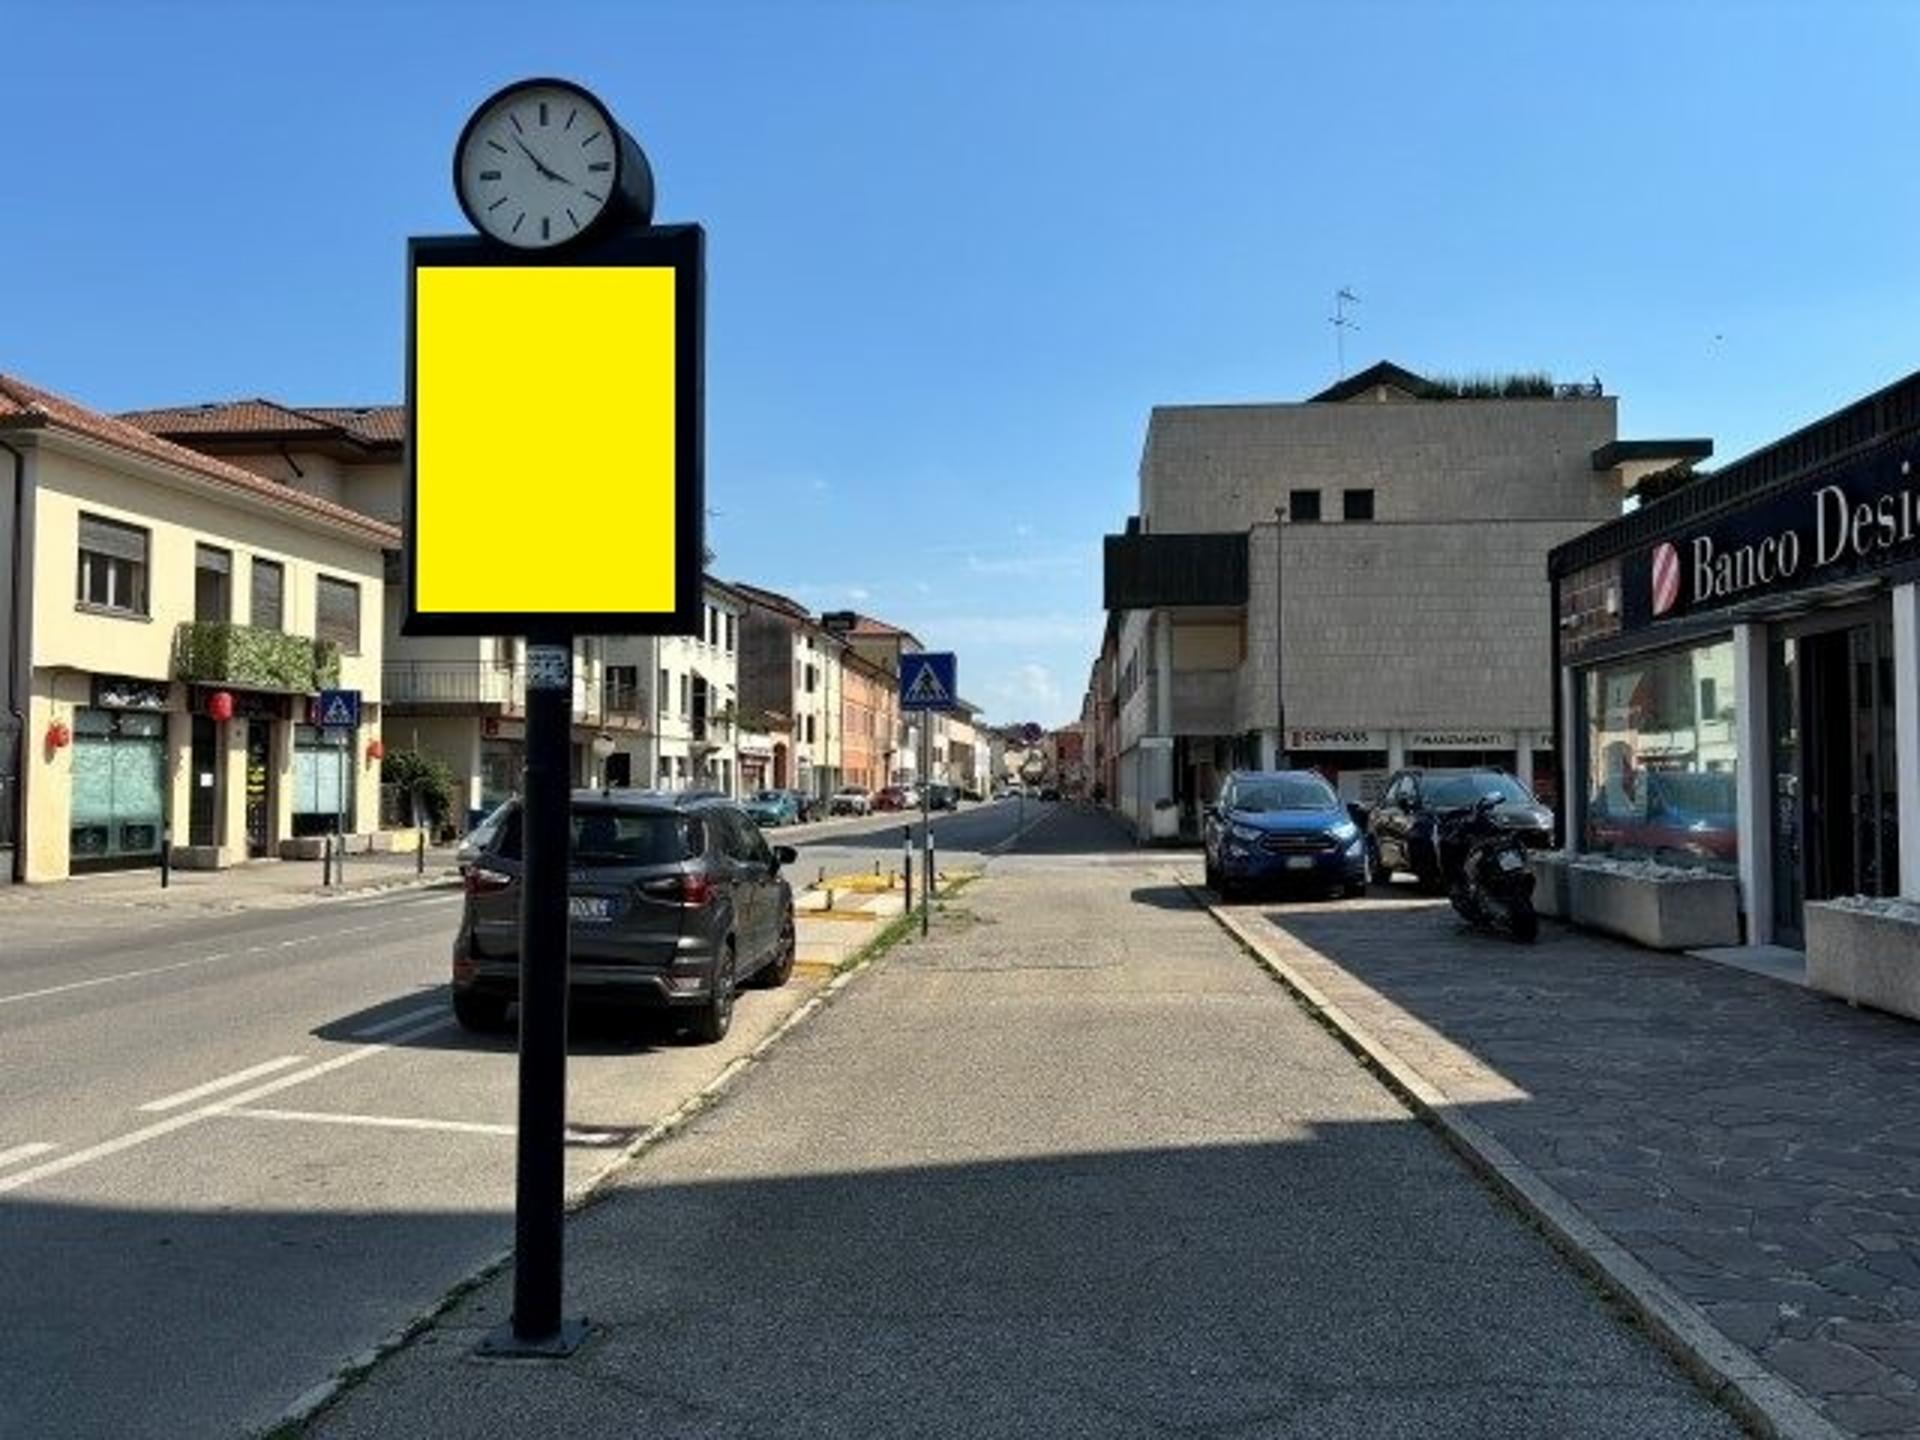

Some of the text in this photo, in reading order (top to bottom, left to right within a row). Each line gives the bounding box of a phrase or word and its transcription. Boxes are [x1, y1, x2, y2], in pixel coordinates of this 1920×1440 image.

[1692, 460, 1920, 604] Banco Desi
[1304, 730, 1369, 743] COMPASS
